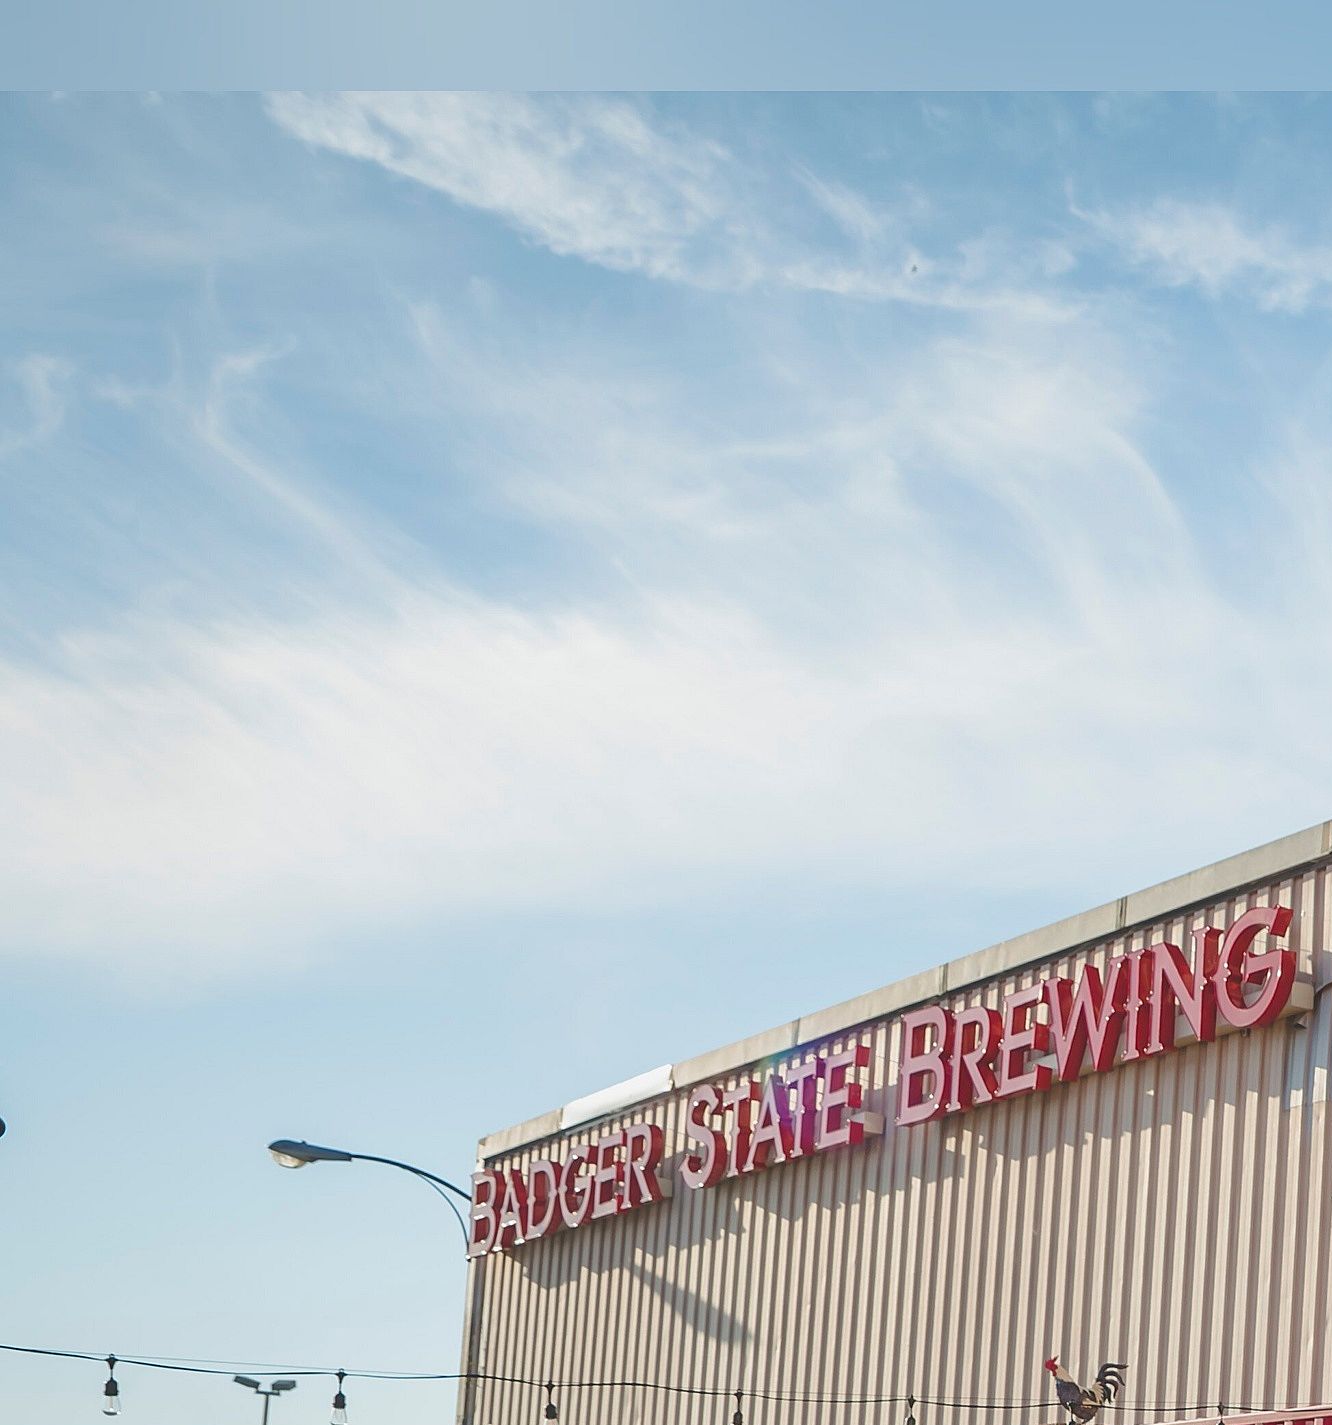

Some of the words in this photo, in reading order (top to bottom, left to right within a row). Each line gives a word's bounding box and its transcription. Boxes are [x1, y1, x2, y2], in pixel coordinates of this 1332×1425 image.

[467, 1121, 664, 1259] BADGER
[679, 1044, 871, 1189] STATE
[897, 904, 1297, 1127] BREWING
